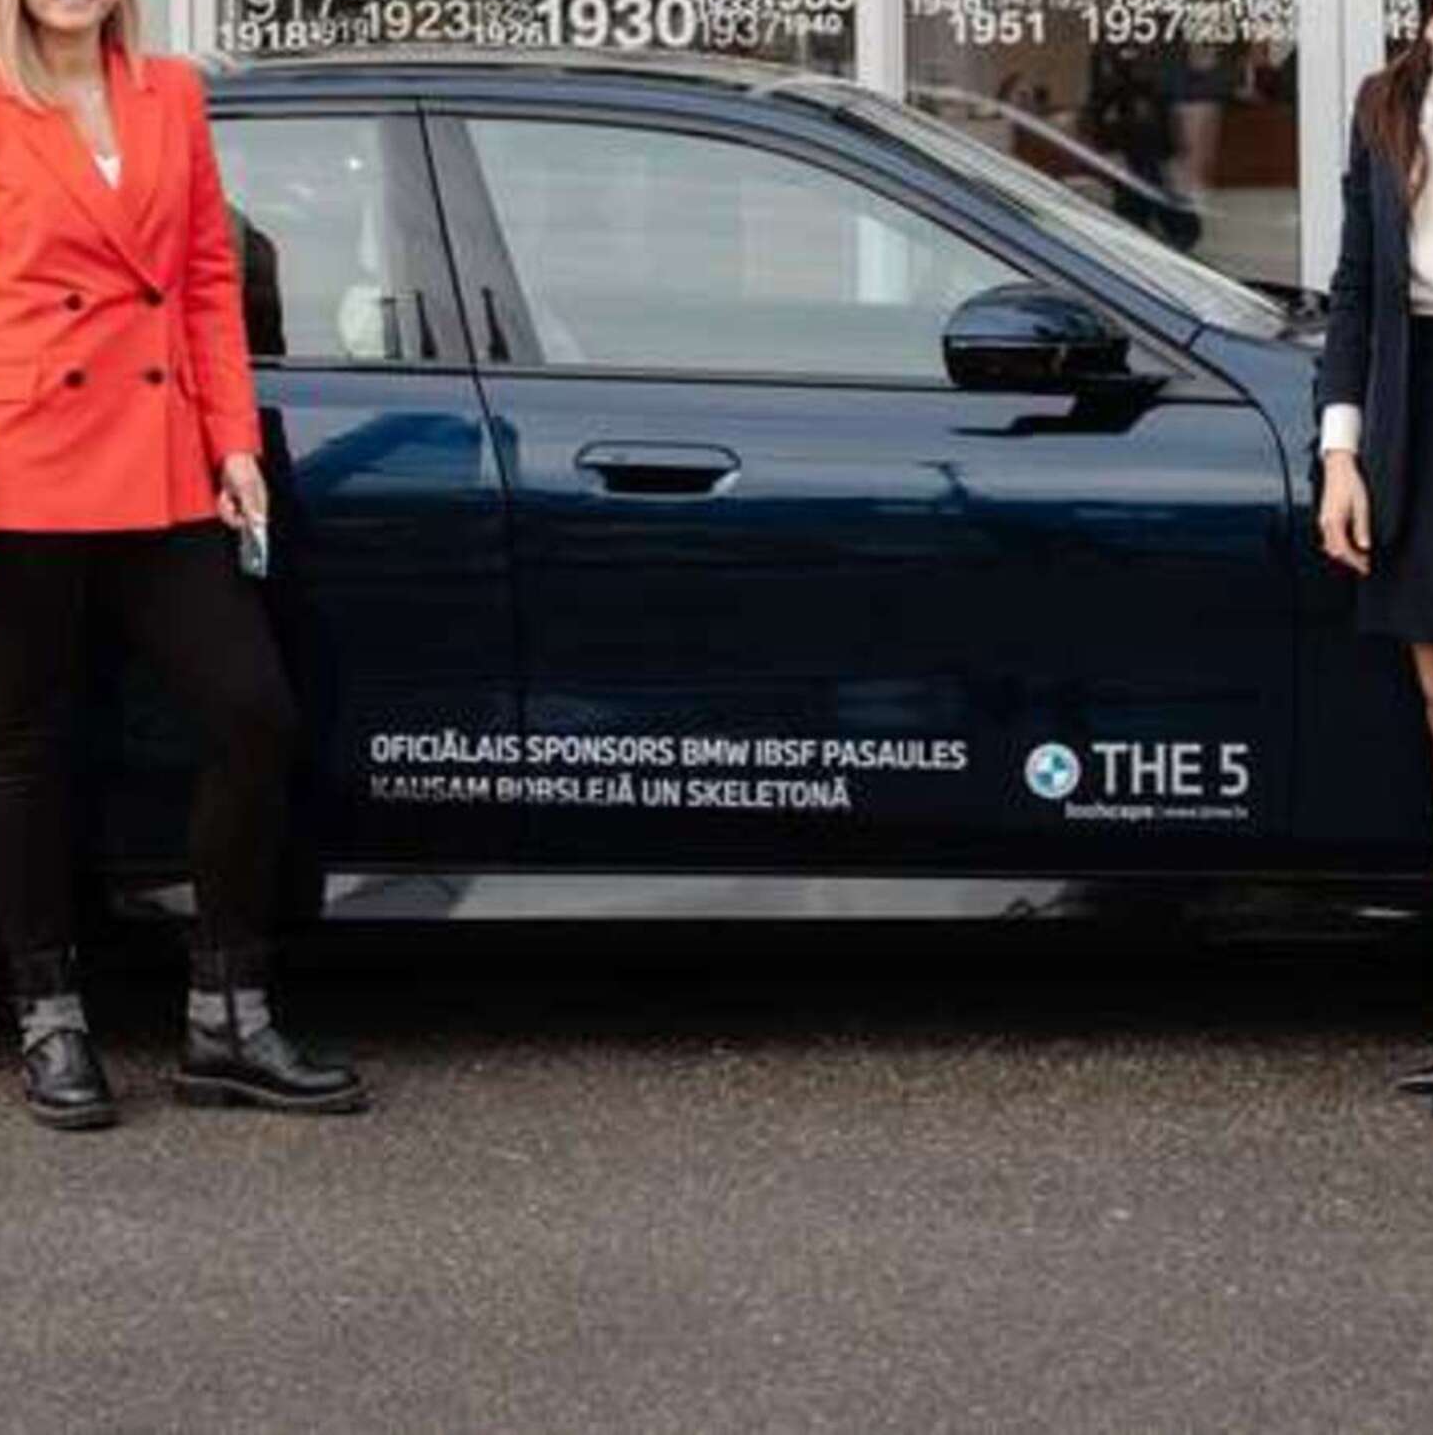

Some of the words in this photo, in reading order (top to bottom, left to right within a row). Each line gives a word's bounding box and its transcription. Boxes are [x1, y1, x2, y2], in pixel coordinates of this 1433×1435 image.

[219, 20, 309, 51] 1918
[362, 0, 471, 40] 1923
[697, 11, 781, 48] 1937
[948, 11, 1045, 45] 1951
[1080, 5, 1186, 45] 1957
[370, 728, 521, 763] OFICIĀLAIS
[525, 734, 676, 765] SPONSORS
[681, 737, 750, 766] BMW
[755, 738, 816, 766] IBSF
[822, 739, 967, 769] PASAULES
[1092, 741, 1203, 795] THE
[1219, 742, 1250, 797] 5
[641, 777, 681, 806] UN
[685, 775, 852, 807] SKELETONĀ
